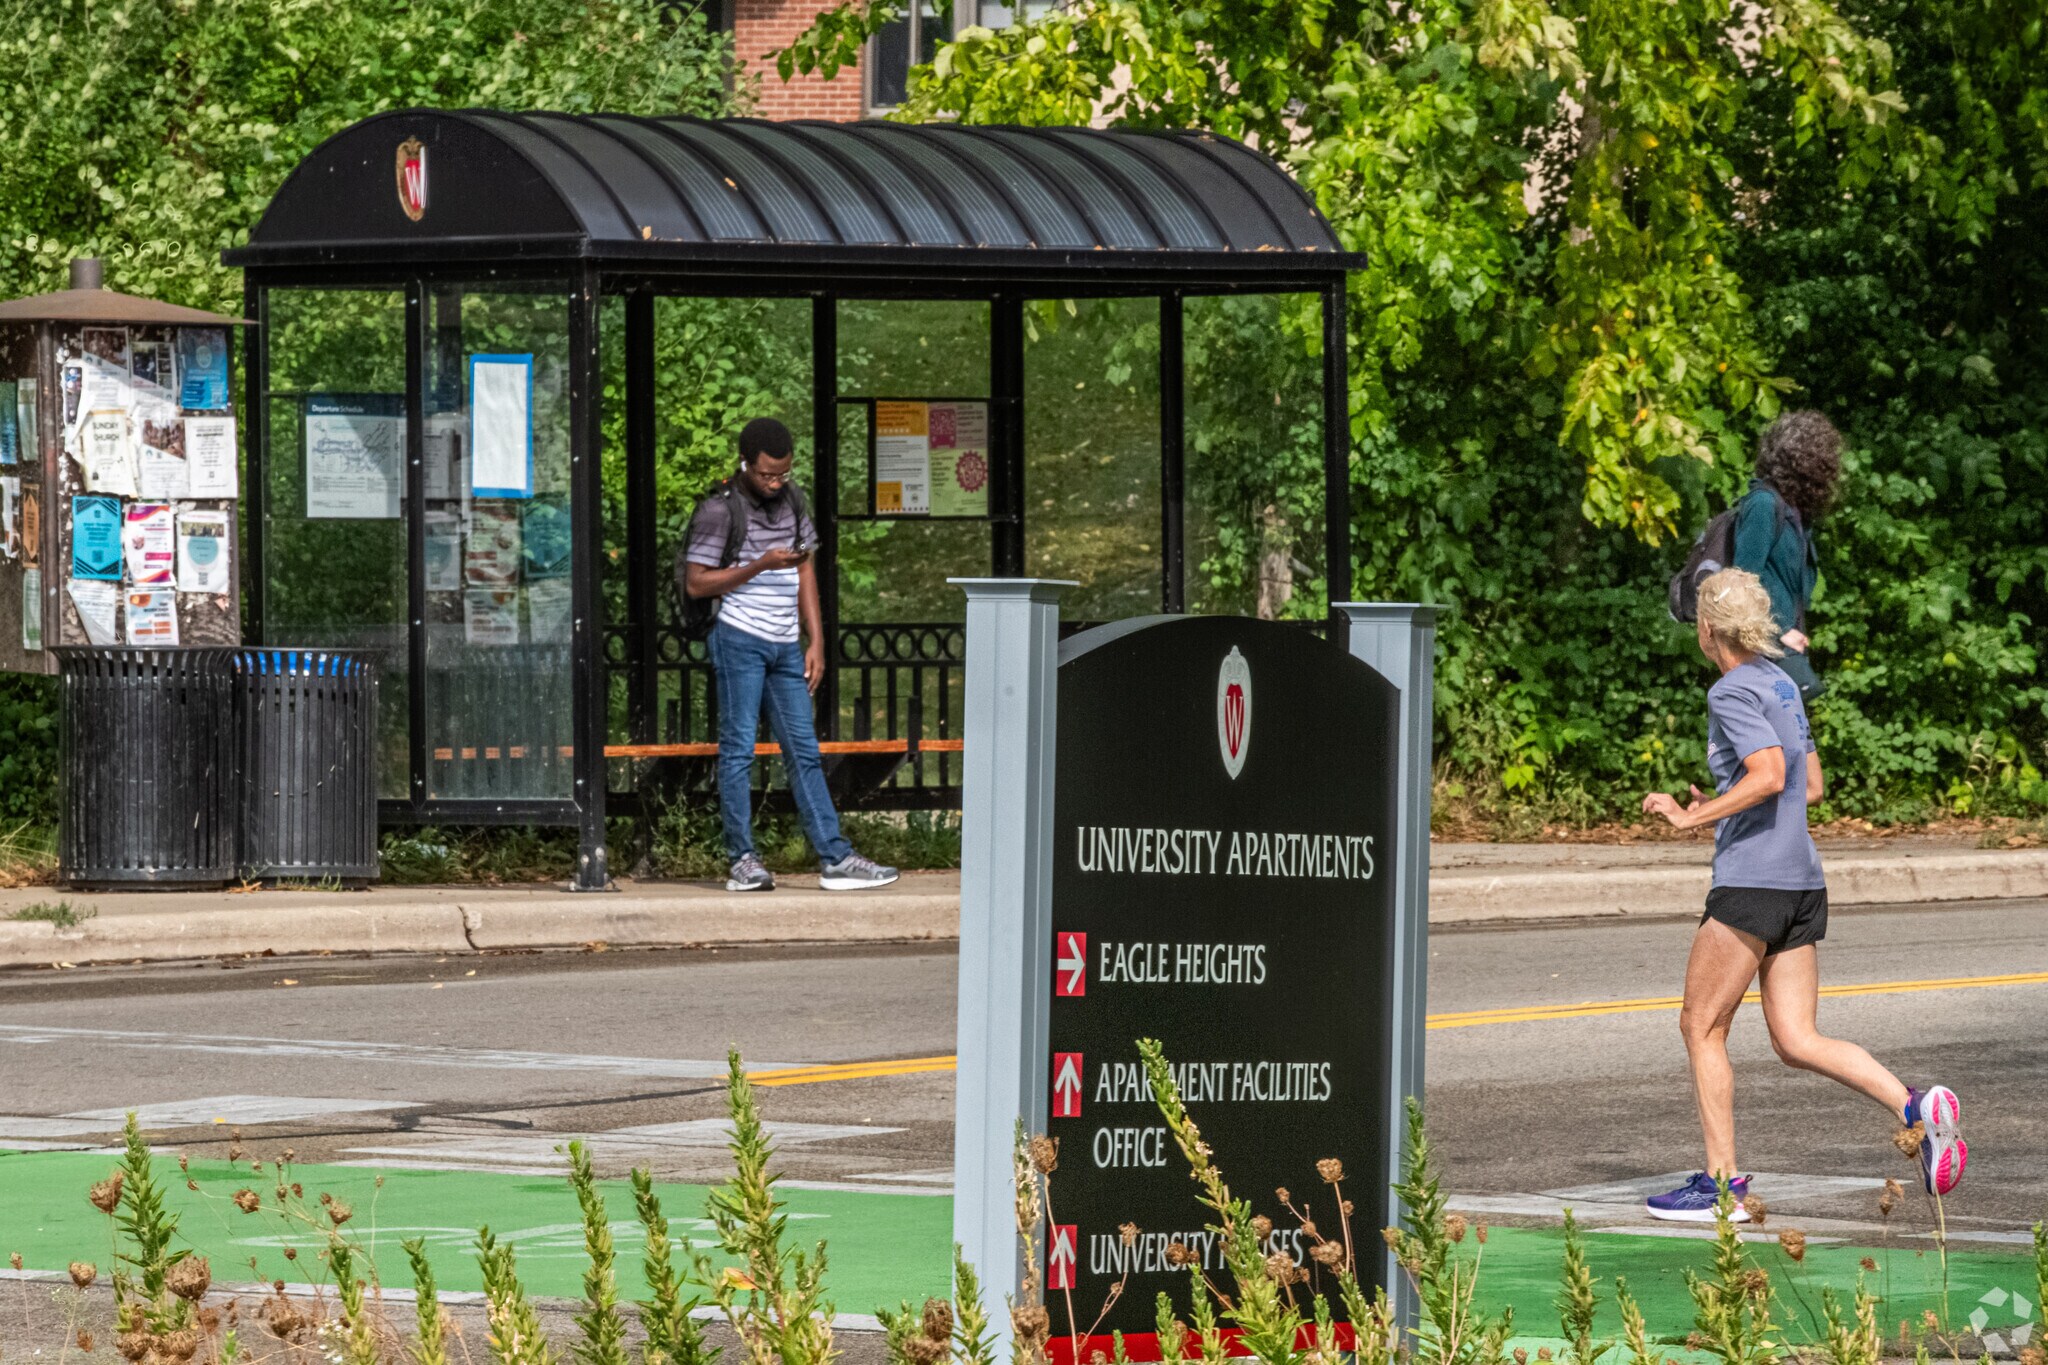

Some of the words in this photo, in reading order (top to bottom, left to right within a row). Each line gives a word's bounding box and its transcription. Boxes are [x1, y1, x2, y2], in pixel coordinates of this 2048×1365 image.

[311, 404, 340, 414] Departure
[340, 405, 365, 414] Schedule
[1226, 691, 1244, 751] W
[1078, 827, 1222, 874] UNIVERSITY
[1226, 832, 1374, 880] APARTMENTS
[1099, 942, 1171, 983] EAGLE
[1174, 943, 1267, 985] HEIGHTS
[1094, 1062, 1229, 1103] APARMENT
[1231, 1060, 1332, 1102] FACILITIES
[1093, 1126, 1168, 1169] OFFICE
[1218, 1228, 1304, 1270] SES
